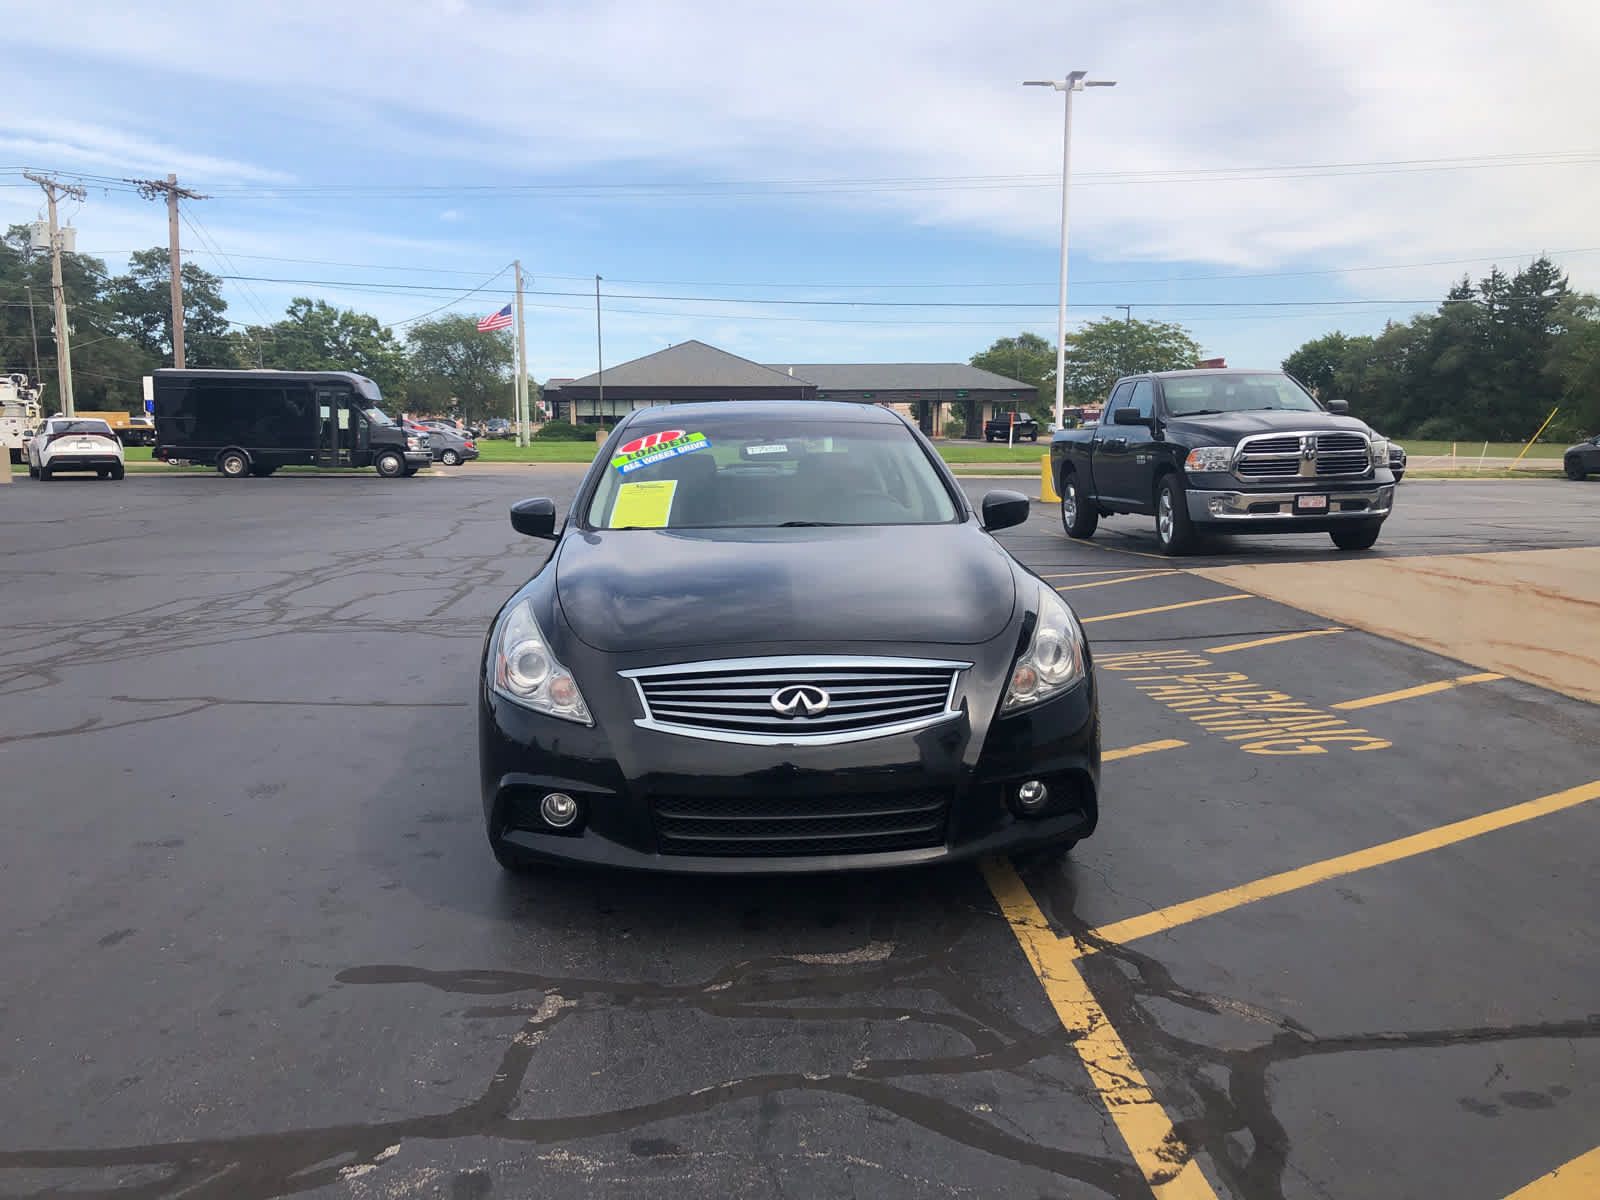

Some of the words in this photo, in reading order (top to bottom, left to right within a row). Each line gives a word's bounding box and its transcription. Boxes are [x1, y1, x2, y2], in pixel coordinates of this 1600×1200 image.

[623, 461, 644, 473] ALL
[642, 450, 679, 465] WHEEL
[677, 440, 706, 454] DRIVE
[626, 436, 691, 460] LOADED
[1091, 649, 1214, 671] NO
[1119, 671, 1393, 756] PARKING
